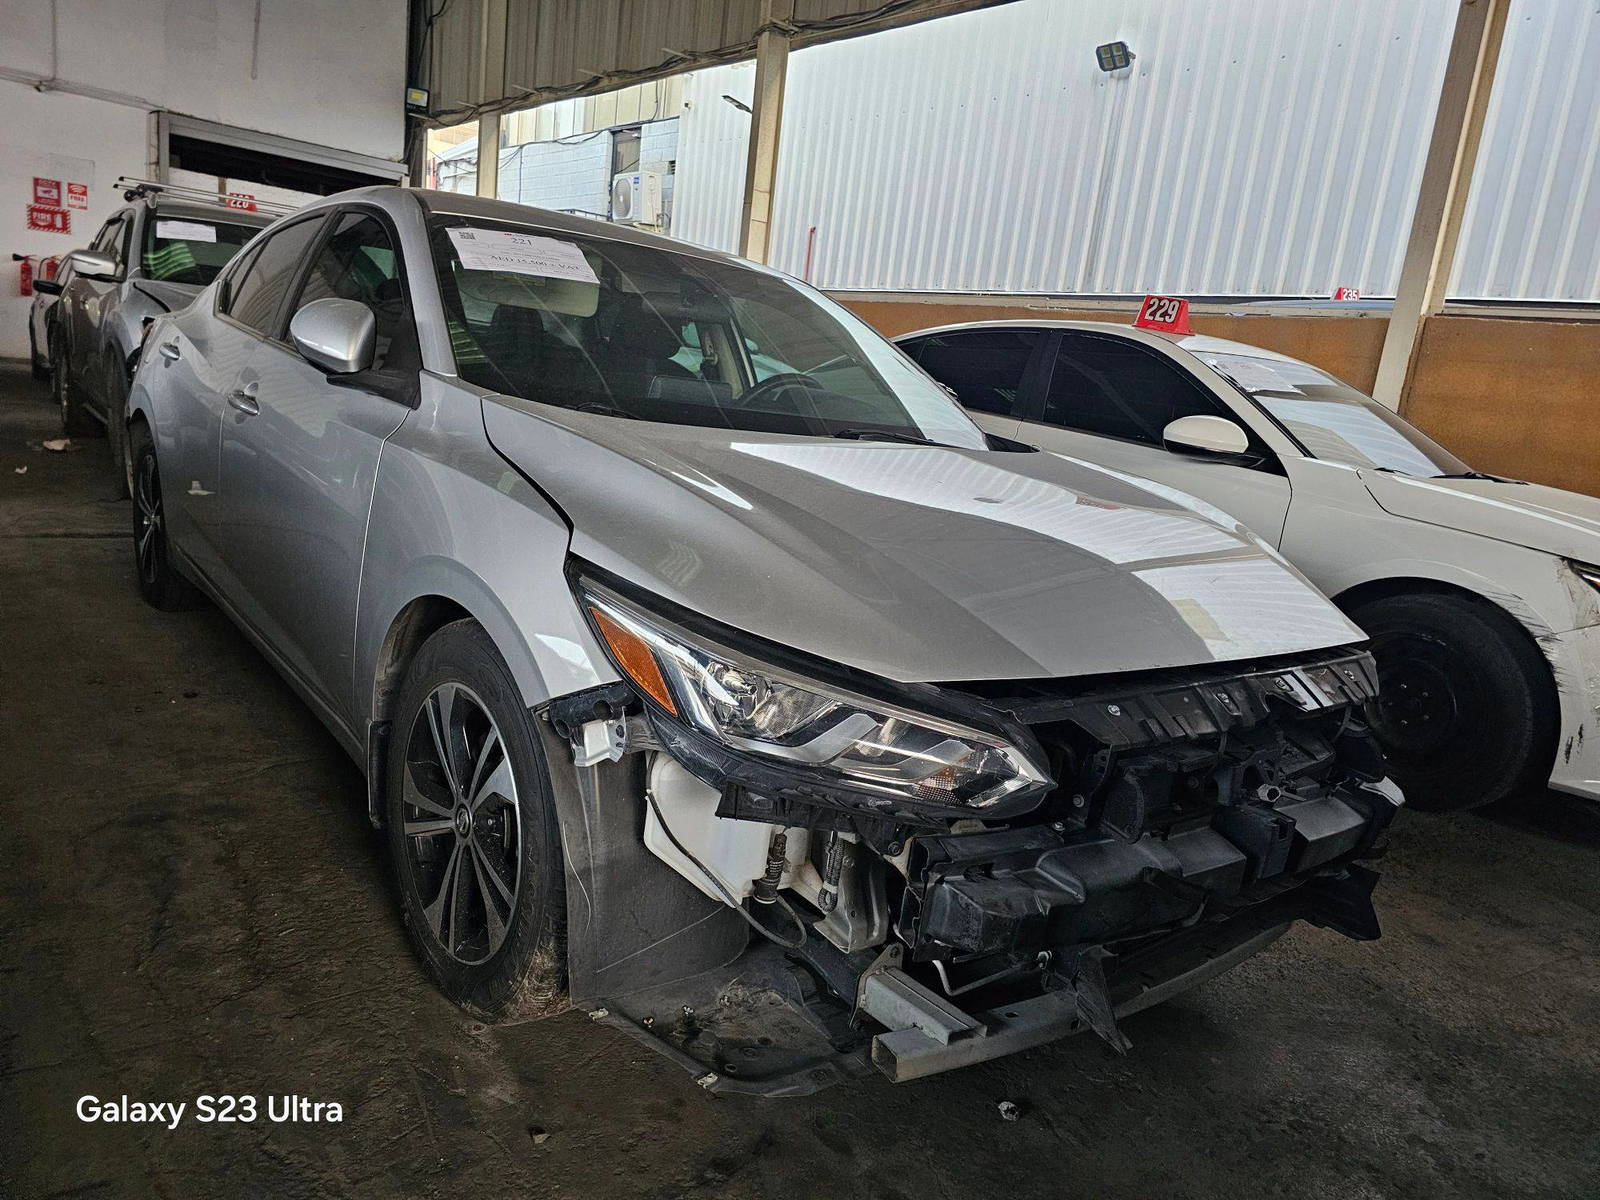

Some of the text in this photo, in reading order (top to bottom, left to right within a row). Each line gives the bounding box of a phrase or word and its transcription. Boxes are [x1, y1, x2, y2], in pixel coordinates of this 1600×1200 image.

[511, 237, 533, 246] 221
[1342, 288, 1359, 301] 235
[1144, 297, 1181, 324] 229
